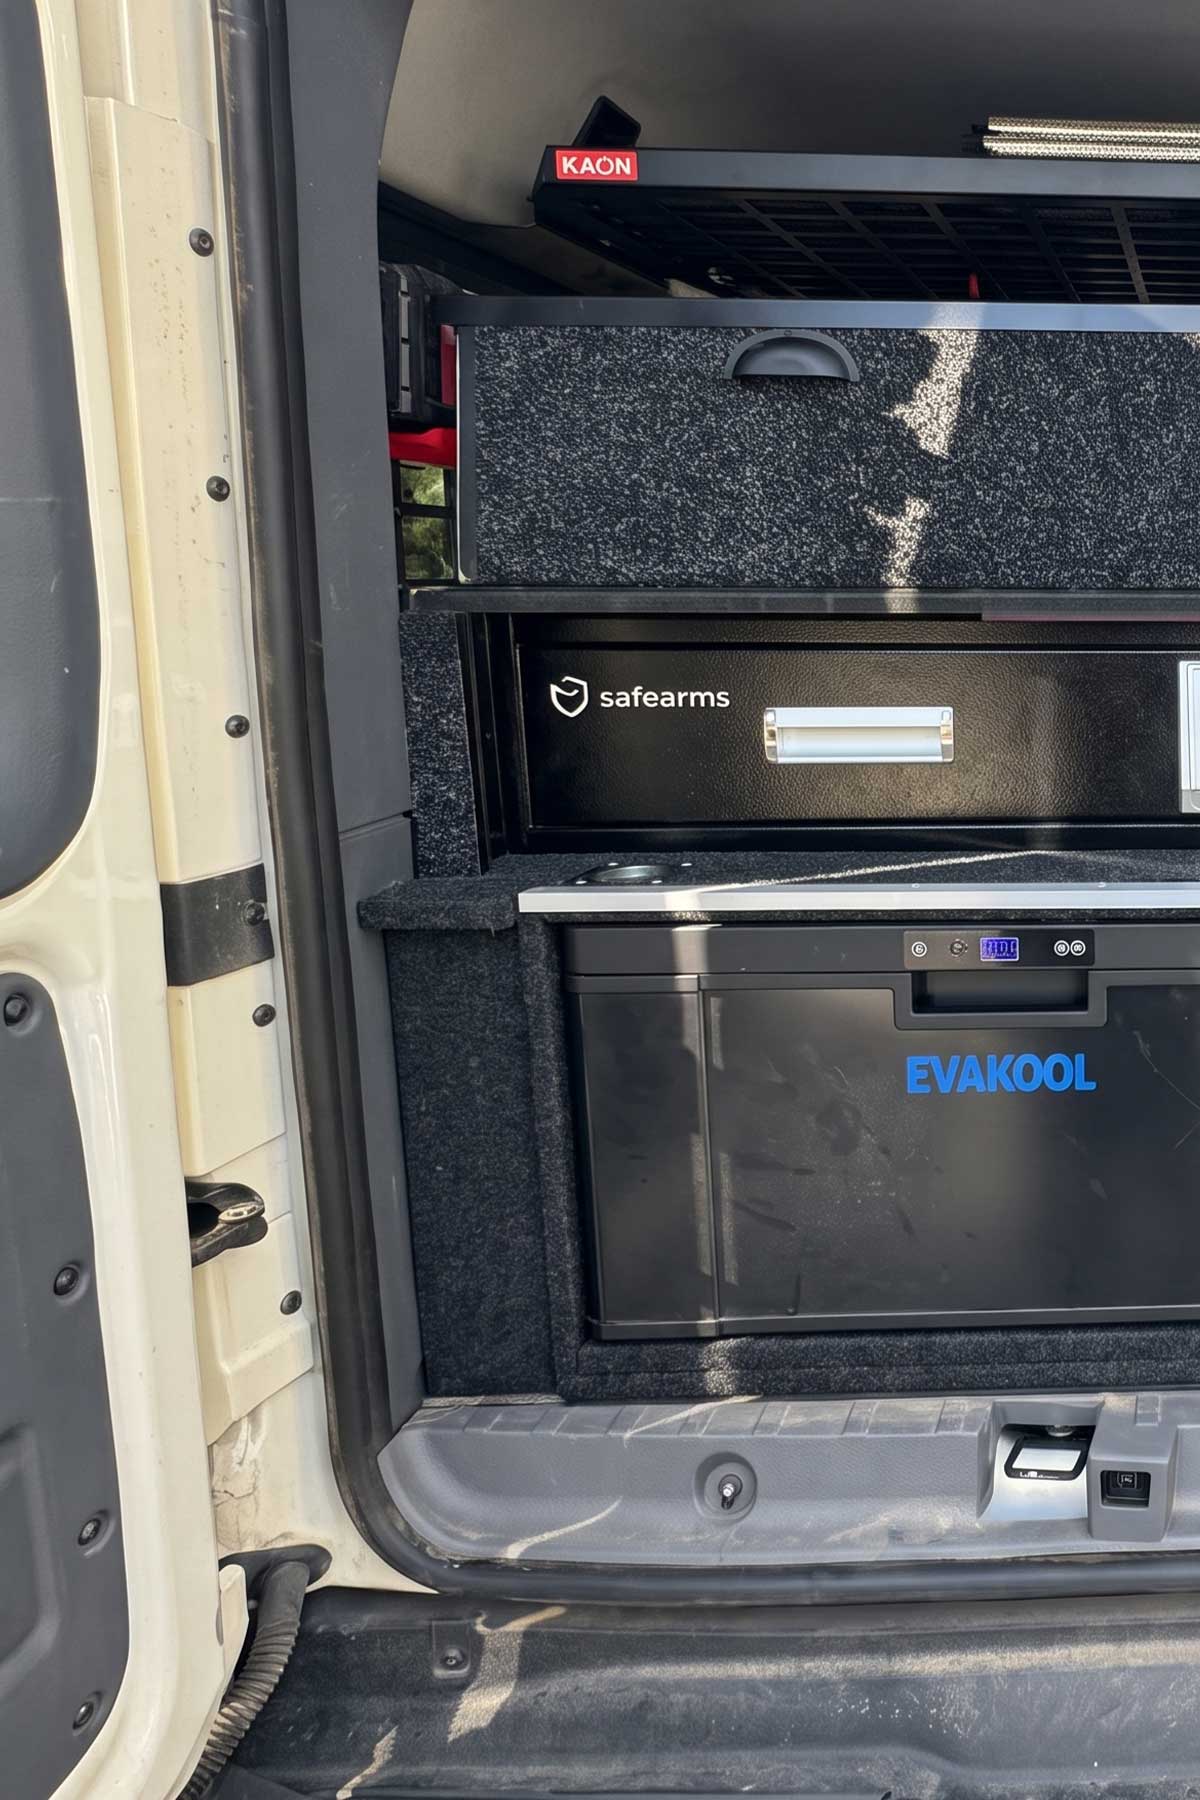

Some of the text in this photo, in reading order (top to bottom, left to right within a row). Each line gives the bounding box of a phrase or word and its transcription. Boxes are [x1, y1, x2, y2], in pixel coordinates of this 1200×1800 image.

[561, 155, 631, 177] KAON
[600, 685, 730, 708] safearms
[906, 1053, 1097, 1094] EVAKOOL
